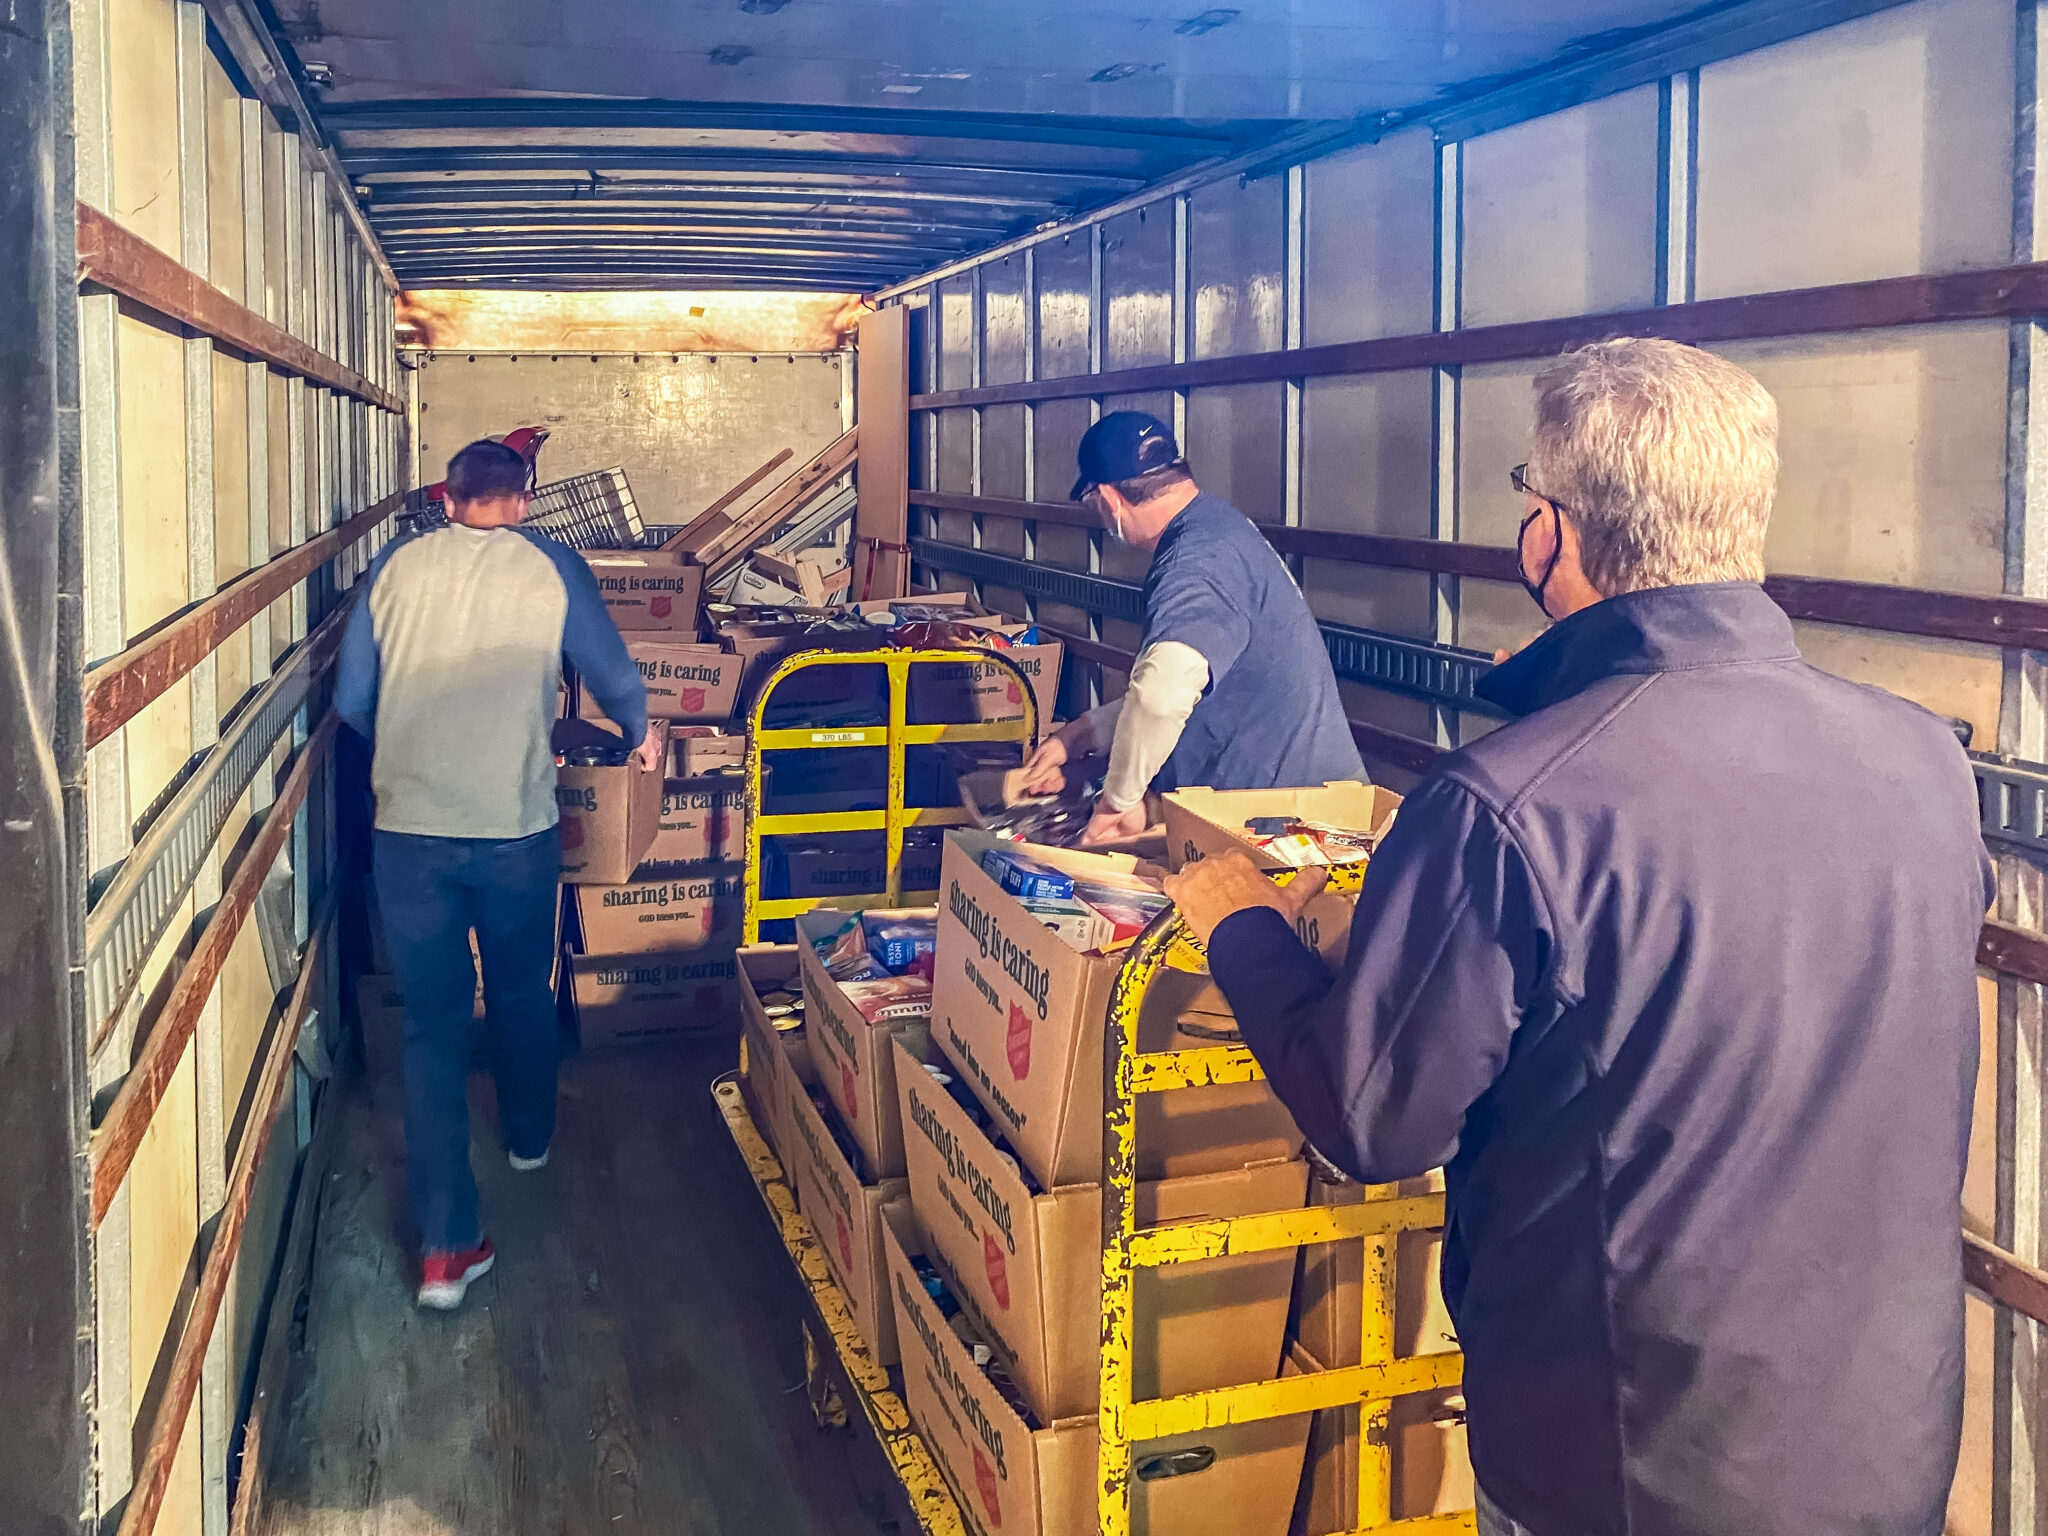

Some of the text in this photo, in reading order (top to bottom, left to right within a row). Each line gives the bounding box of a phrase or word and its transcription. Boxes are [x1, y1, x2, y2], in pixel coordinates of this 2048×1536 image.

[599, 576, 684, 594] ring is caring
[660, 661, 672, 678] is
[674, 664, 721, 687] caring
[998, 657, 1042, 677] cing
[674, 794, 688, 811] is
[603, 886, 669, 907] sharing
[671, 883, 686, 902] is
[638, 913, 655, 923] GOD
[894, 942, 902, 965] RONI
[950, 879, 990, 959] sharing
[990, 917, 1002, 963] is
[1002, 937, 1050, 1021] caring
[596, 965, 662, 986] sharing
[909, 1087, 955, 1178] sharing
[954, 1135, 967, 1185] is
[968, 1160, 1016, 1256] caring
